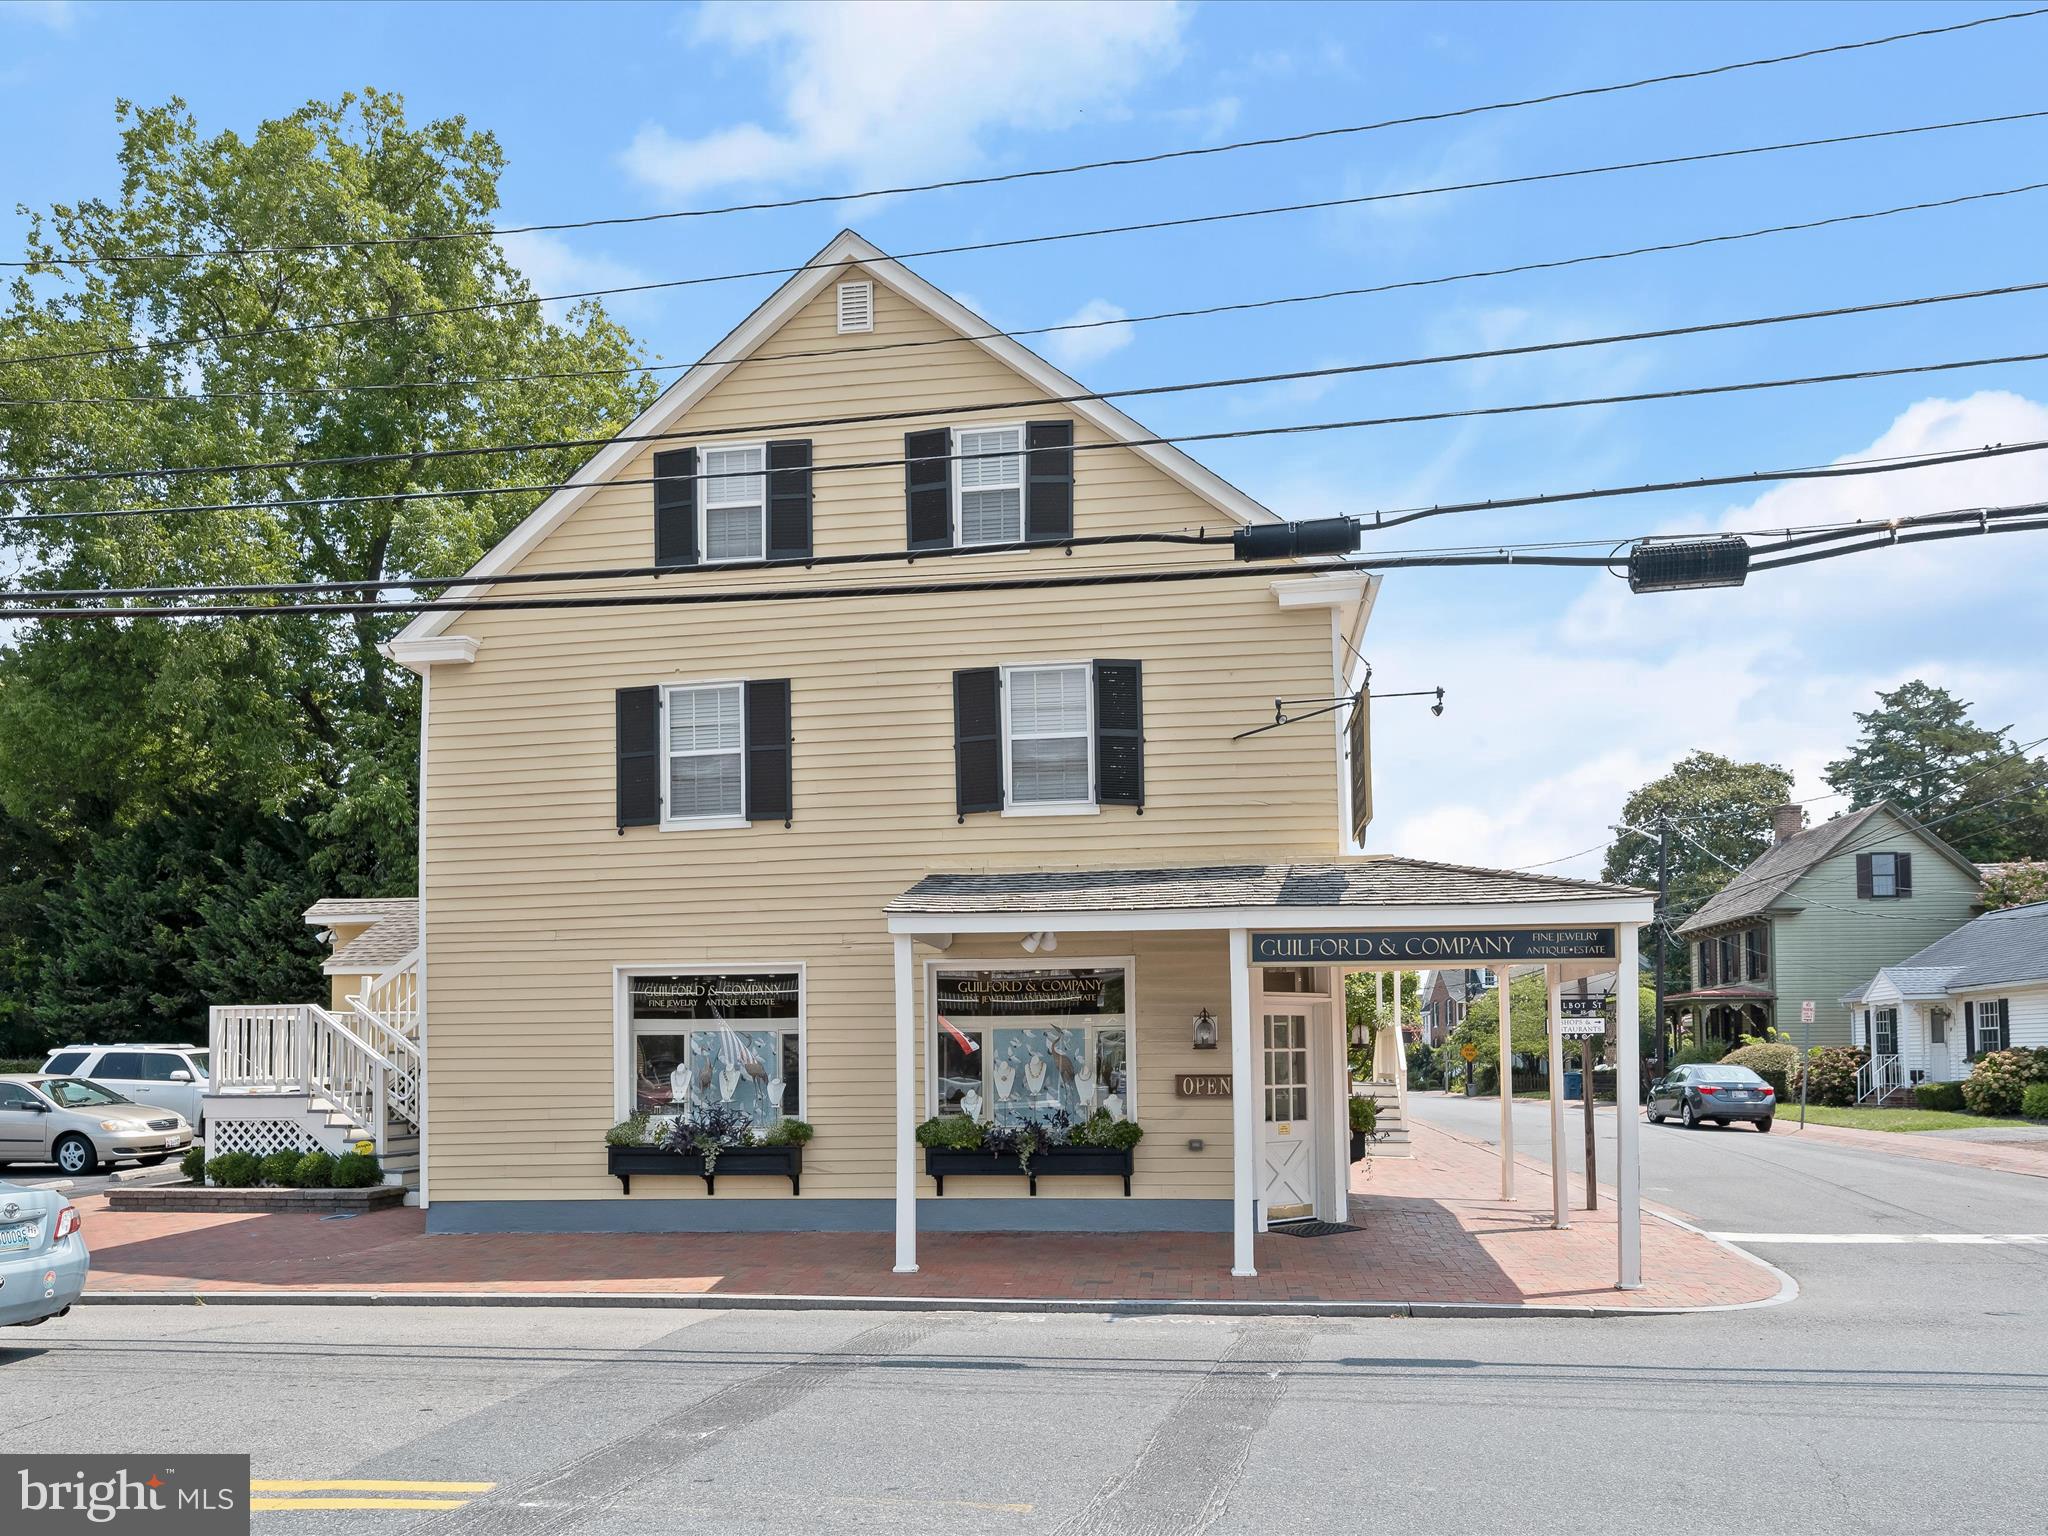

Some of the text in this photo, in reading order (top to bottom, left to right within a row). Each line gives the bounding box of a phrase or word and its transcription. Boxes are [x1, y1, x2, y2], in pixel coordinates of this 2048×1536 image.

[1532, 931, 1599, 943] FINE JEWELRY
[1260, 936, 1515, 956] GUILFORD & COMPANY
[645, 984, 782, 997] GUILFORD & COMPANY
[958, 979, 1103, 993] GUILFORD & COMPANY
[666, 999, 698, 1008] JEWELRY
[705, 999, 739, 1008] ANTIQUE
[750, 998, 775, 1006] ESTATE
[1183, 1077, 1231, 1095] OPEN
[0, 1230, 22, 1245] 0008
